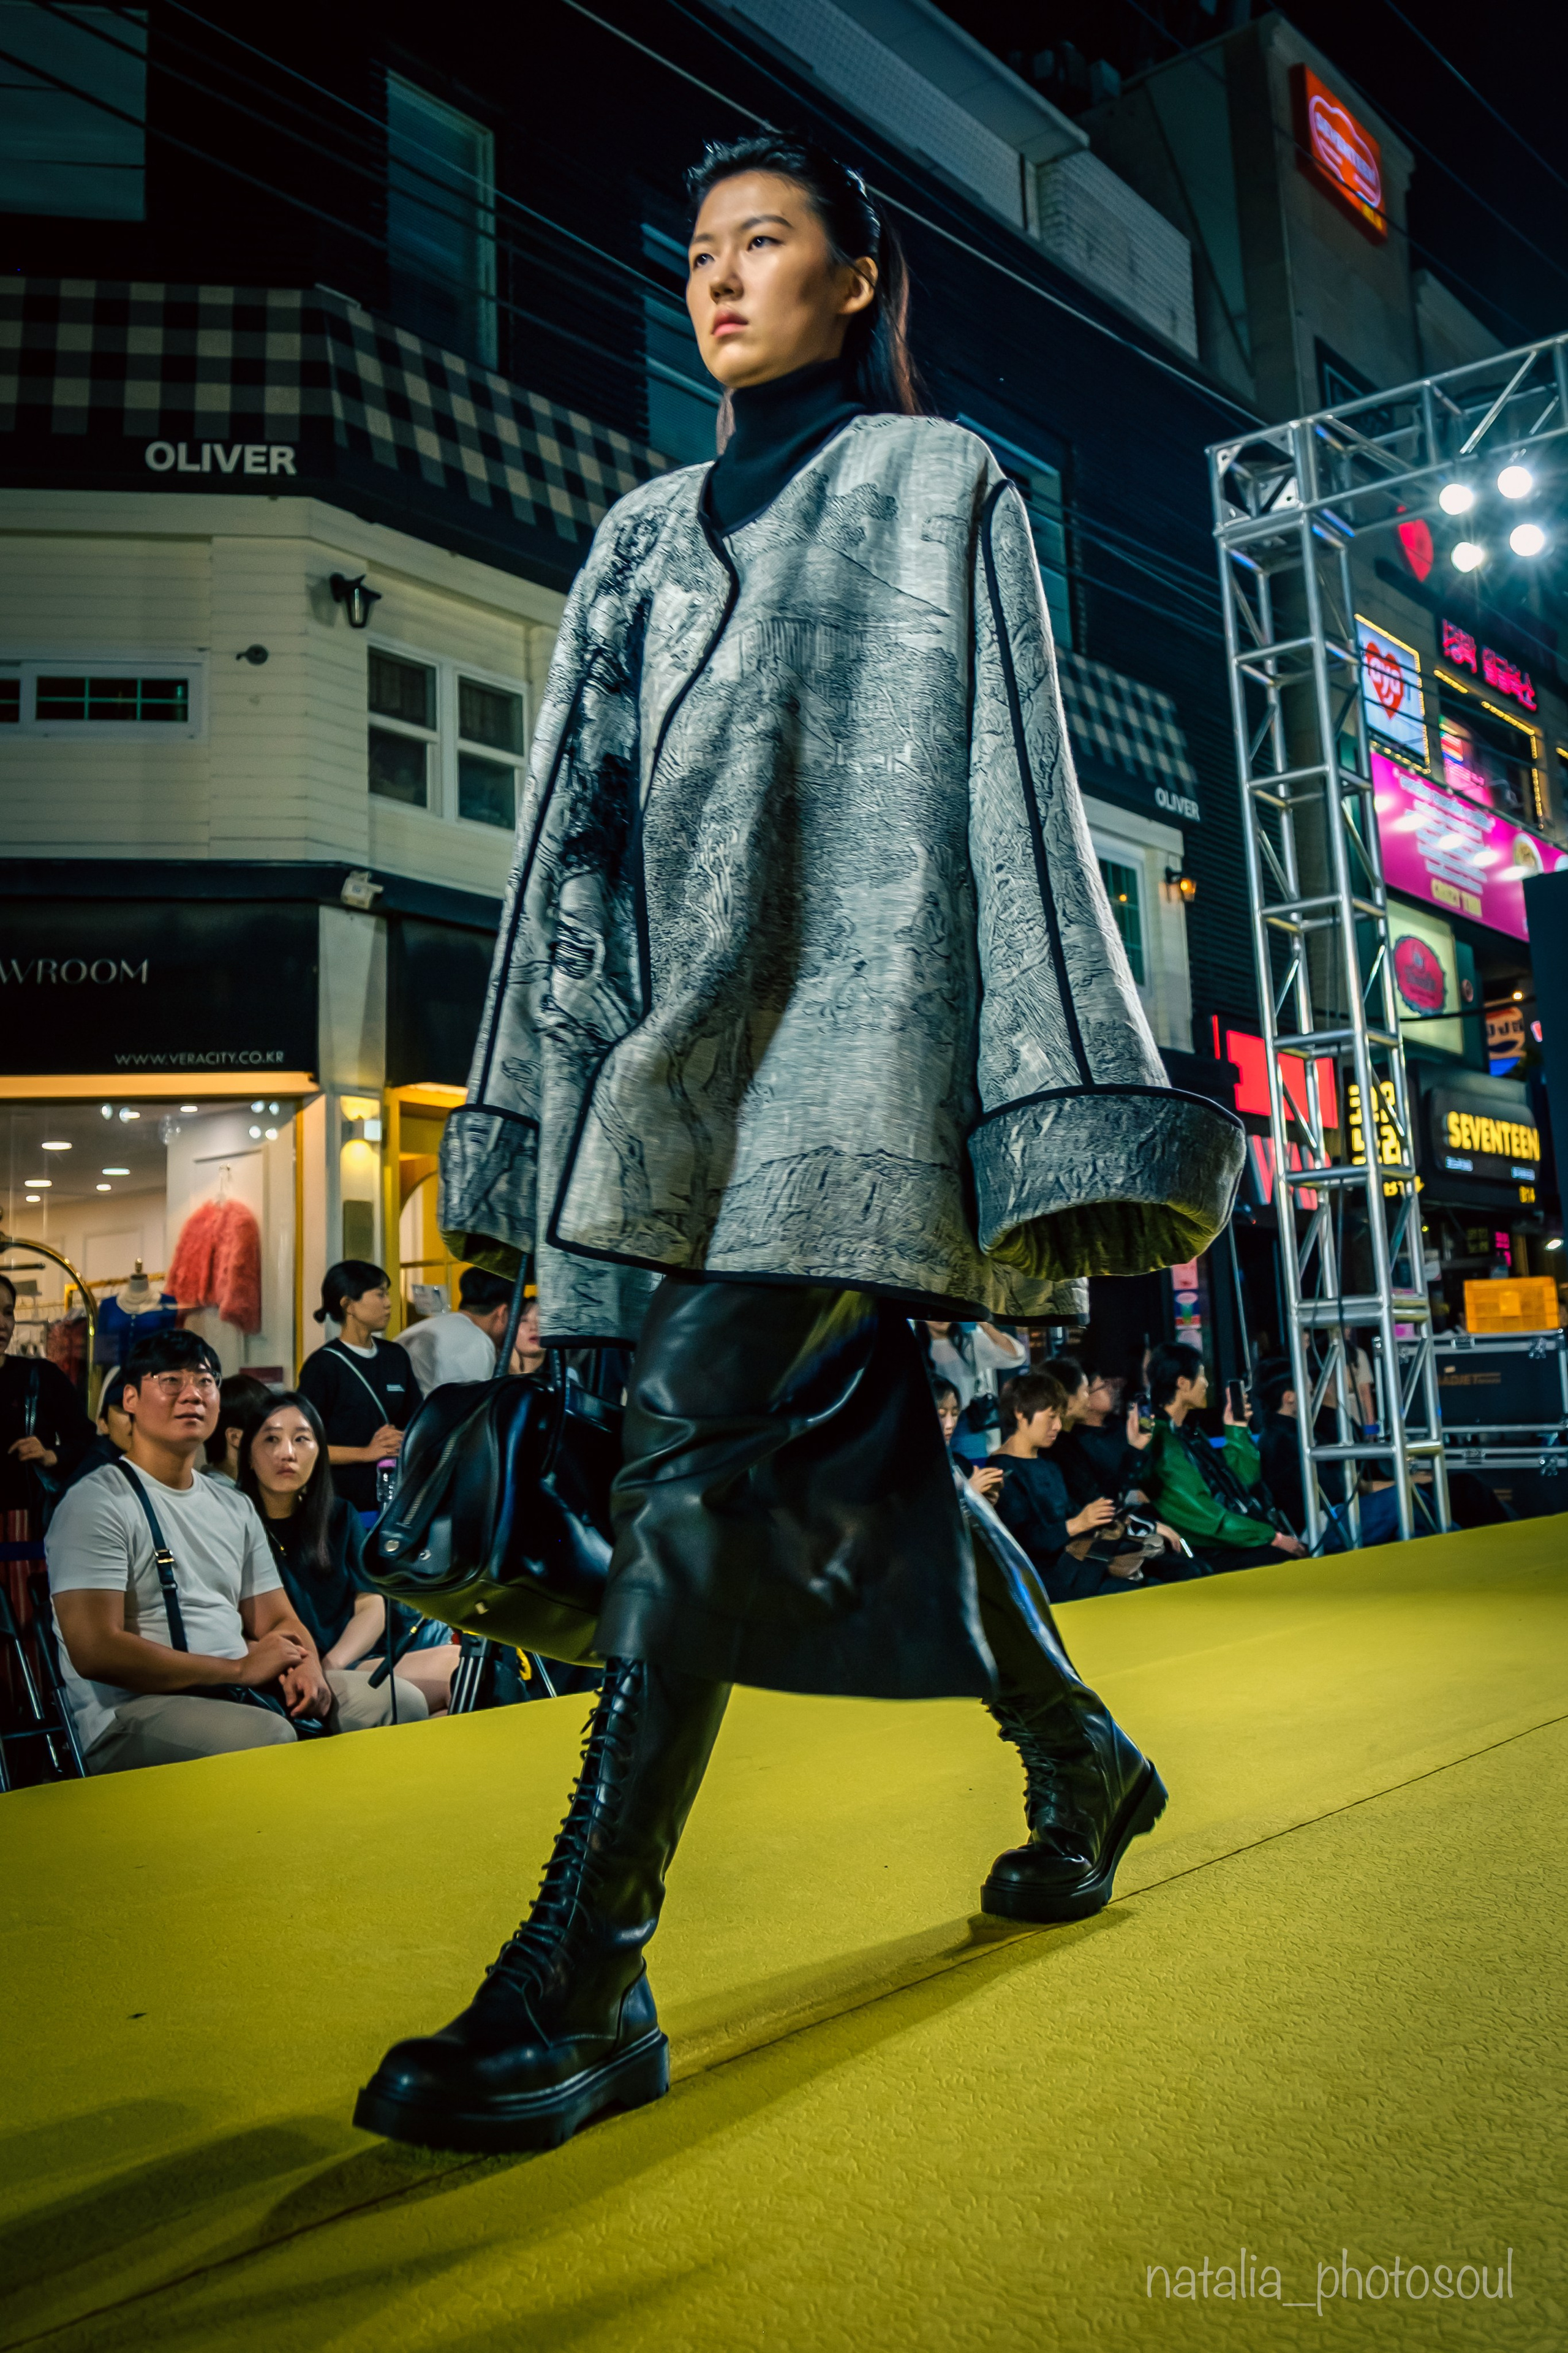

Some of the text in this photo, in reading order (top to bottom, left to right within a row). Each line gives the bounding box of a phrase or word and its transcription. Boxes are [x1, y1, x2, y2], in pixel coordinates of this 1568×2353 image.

[145, 441, 297, 476] OLIVER
[1155, 787, 1200, 822] OLIVER
[0, 958, 149, 984] WROOM
[114, 1050, 284, 1065] WWW.VERACITY.CO.KR
[1446, 1110, 1541, 1161] SEVENTEEN
